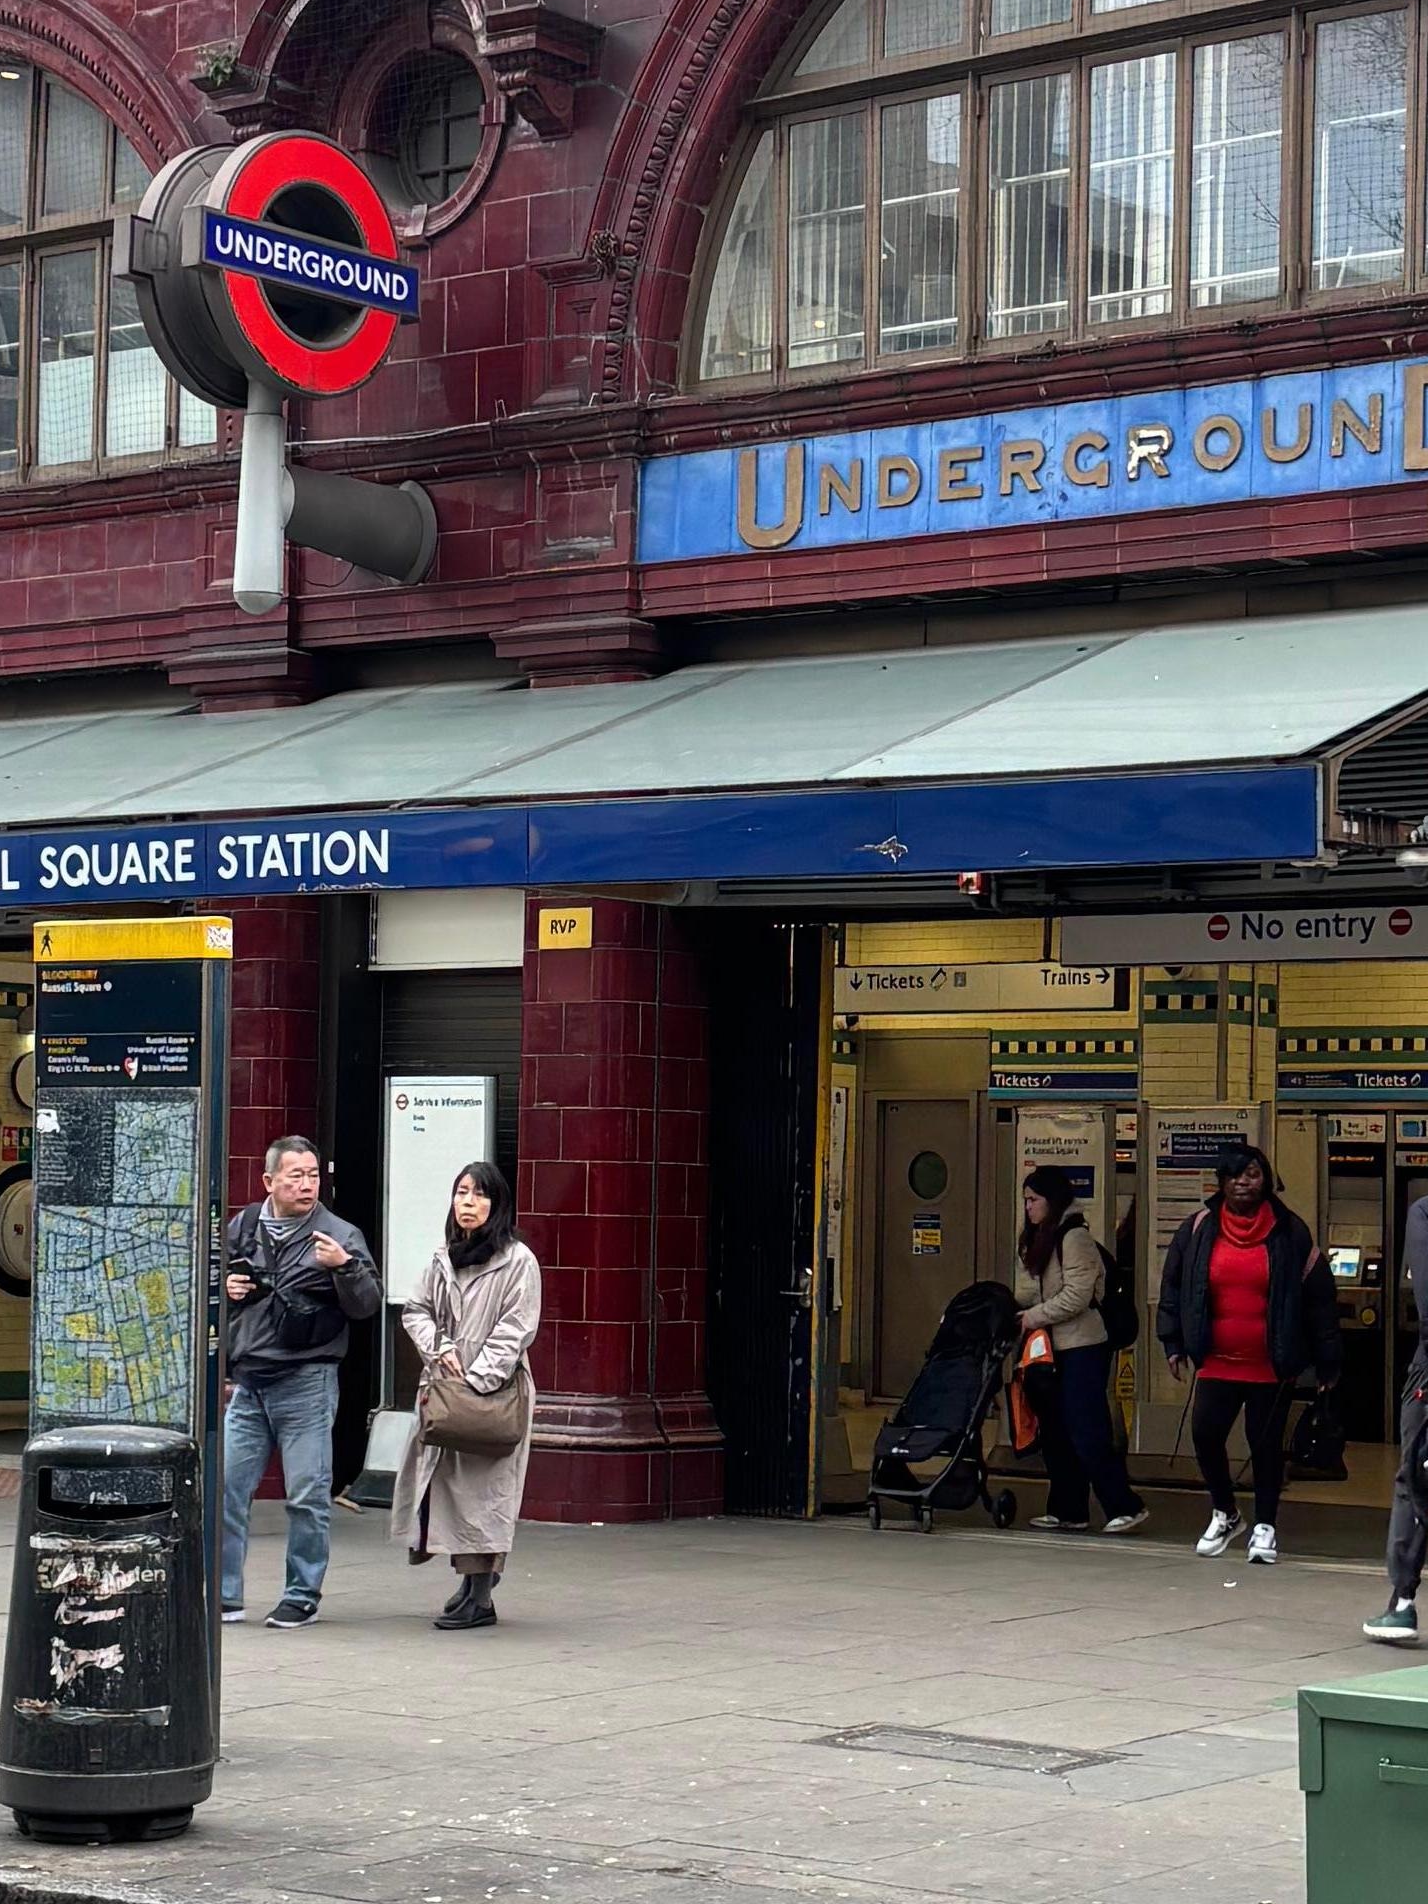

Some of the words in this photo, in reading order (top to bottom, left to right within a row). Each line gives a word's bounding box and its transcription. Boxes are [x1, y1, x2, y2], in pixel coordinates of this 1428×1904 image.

[215, 224, 409, 302] UNDERGROUND
[39, 837, 196, 889] SQUARE
[217, 828, 390, 880] STATION
[550, 918, 577, 934] RVP
[1240, 913, 1284, 941] No
[1294, 913, 1376, 944] entry
[73, 981, 102, 994] Square
[866, 972, 924, 991] Tickets
[1040, 968, 1091, 987] Trains
[993, 1072, 1040, 1088] Tickets
[1354, 1072, 1408, 1087] Tickets
[1157, 1120, 1196, 1131] Planned
[1198, 1121, 1239, 1131] closures
